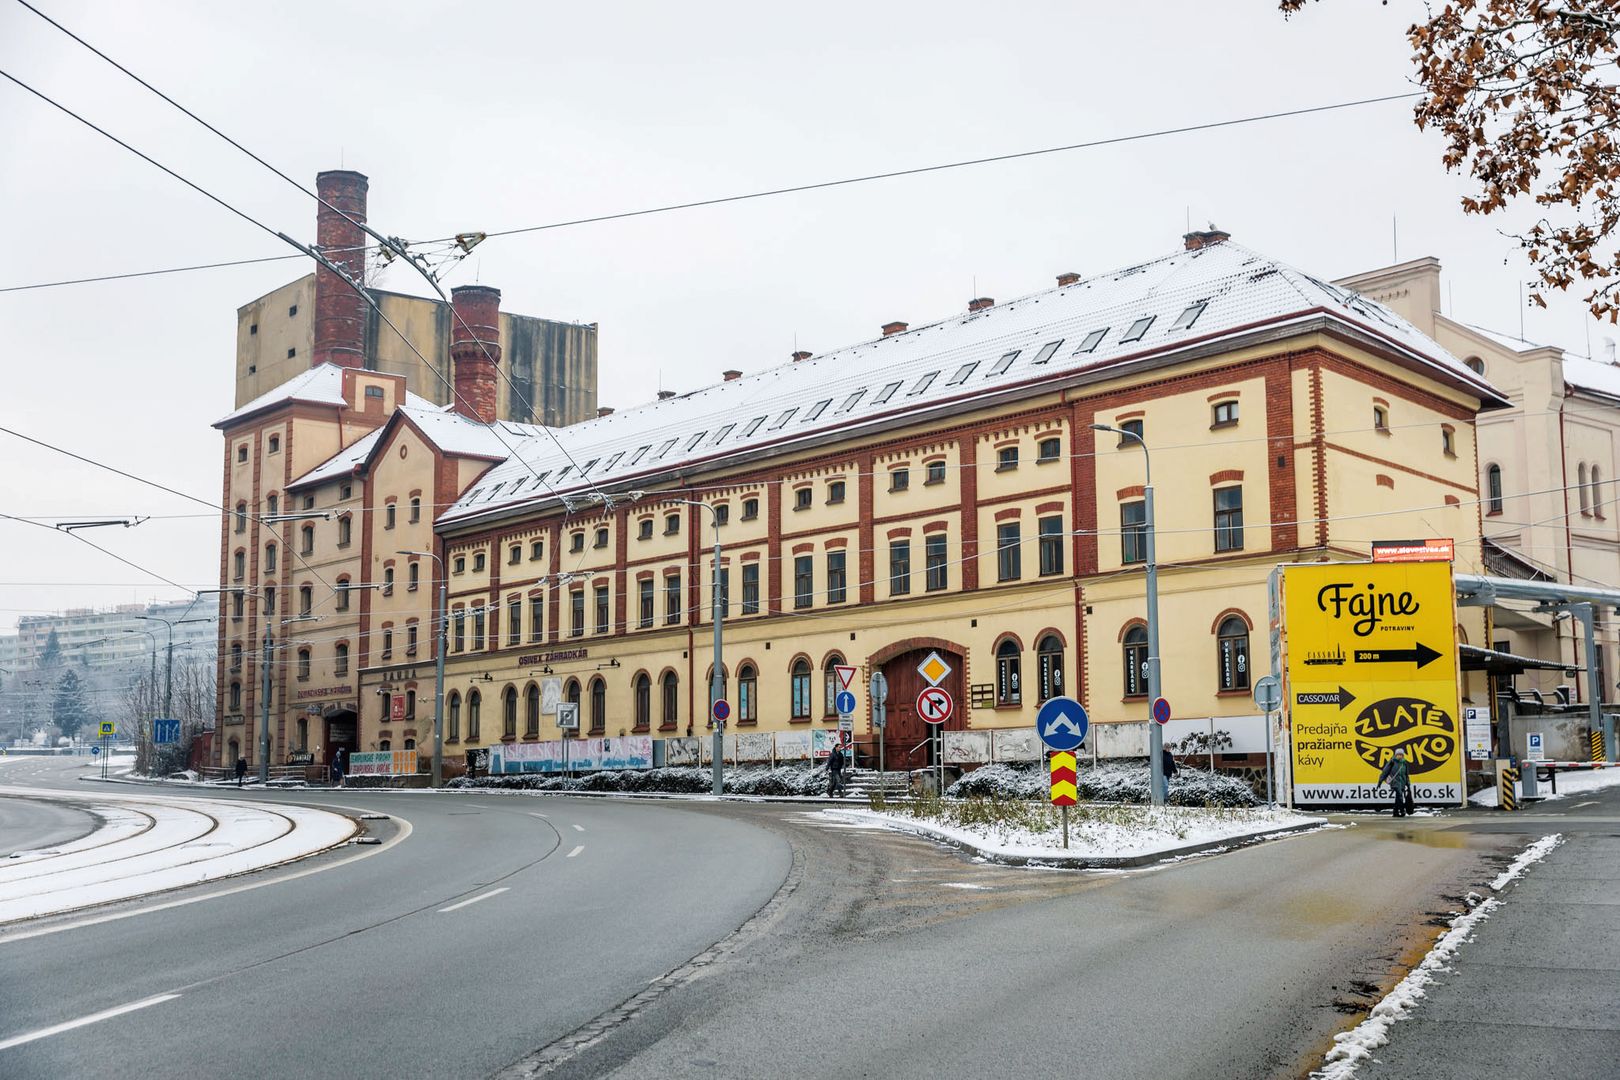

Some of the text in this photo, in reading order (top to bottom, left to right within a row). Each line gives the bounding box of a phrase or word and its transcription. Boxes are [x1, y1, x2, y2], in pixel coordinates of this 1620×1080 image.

[1317, 583, 1420, 637] Fajne
[1298, 694, 1340, 703] CASSOVAR
[1354, 703, 1445, 735] ZLATÉ
[1467, 710, 1475, 719] P
[1297, 723, 1348, 737] Predajňa
[1297, 739, 1353, 753] pražiarne
[1531, 736, 1539, 746] P
[1297, 755, 1325, 768] kávy
